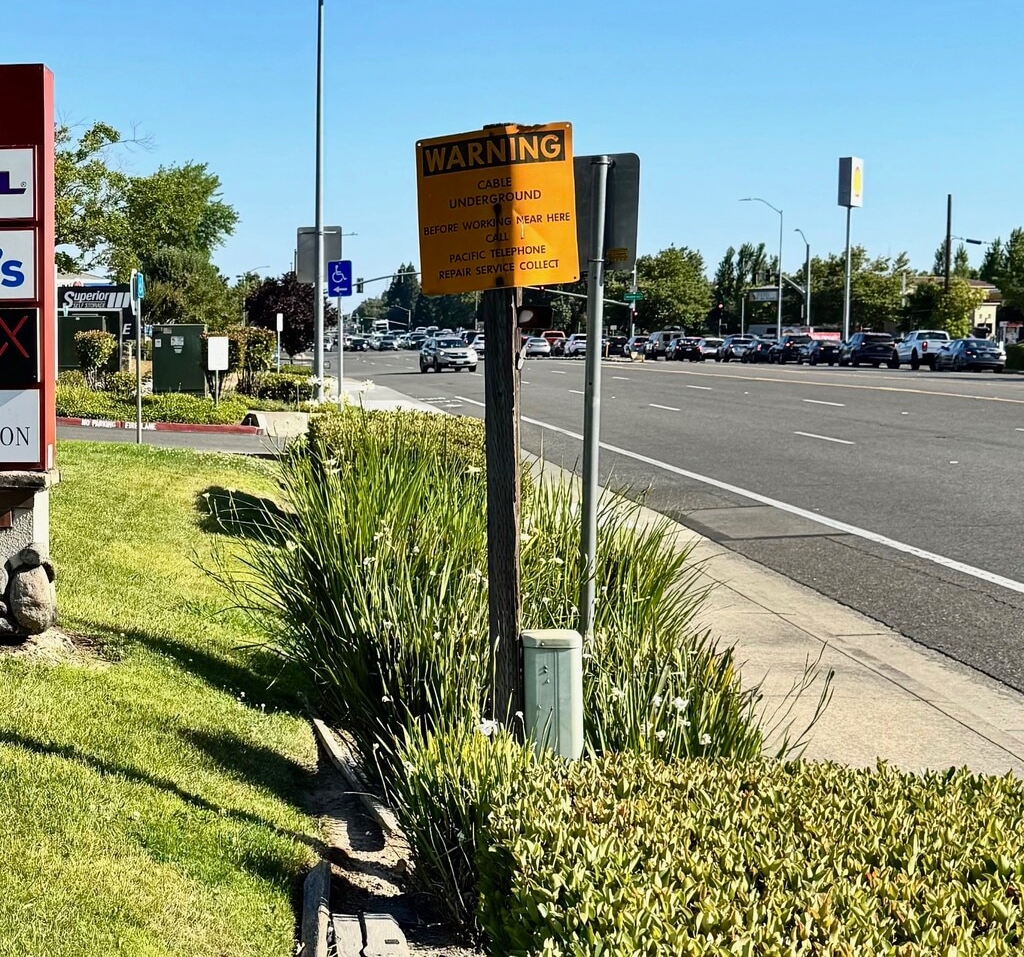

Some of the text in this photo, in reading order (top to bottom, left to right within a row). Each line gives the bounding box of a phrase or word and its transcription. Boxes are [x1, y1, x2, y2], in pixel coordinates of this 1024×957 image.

[425, 133, 561, 173] WARNING
[477, 176, 512, 190] CABLE
[449, 189, 542, 209] UNDERGROUND
[423, 212, 571, 236] BEFORE WORKING NEAR HERE
[485, 232, 509, 244] CALL
[449, 244, 546, 264] PACIFIC TELEPHONE
[438, 259, 560, 280] REPAIR SERVICE COLLECT
[63, 290, 111, 308] Superior
